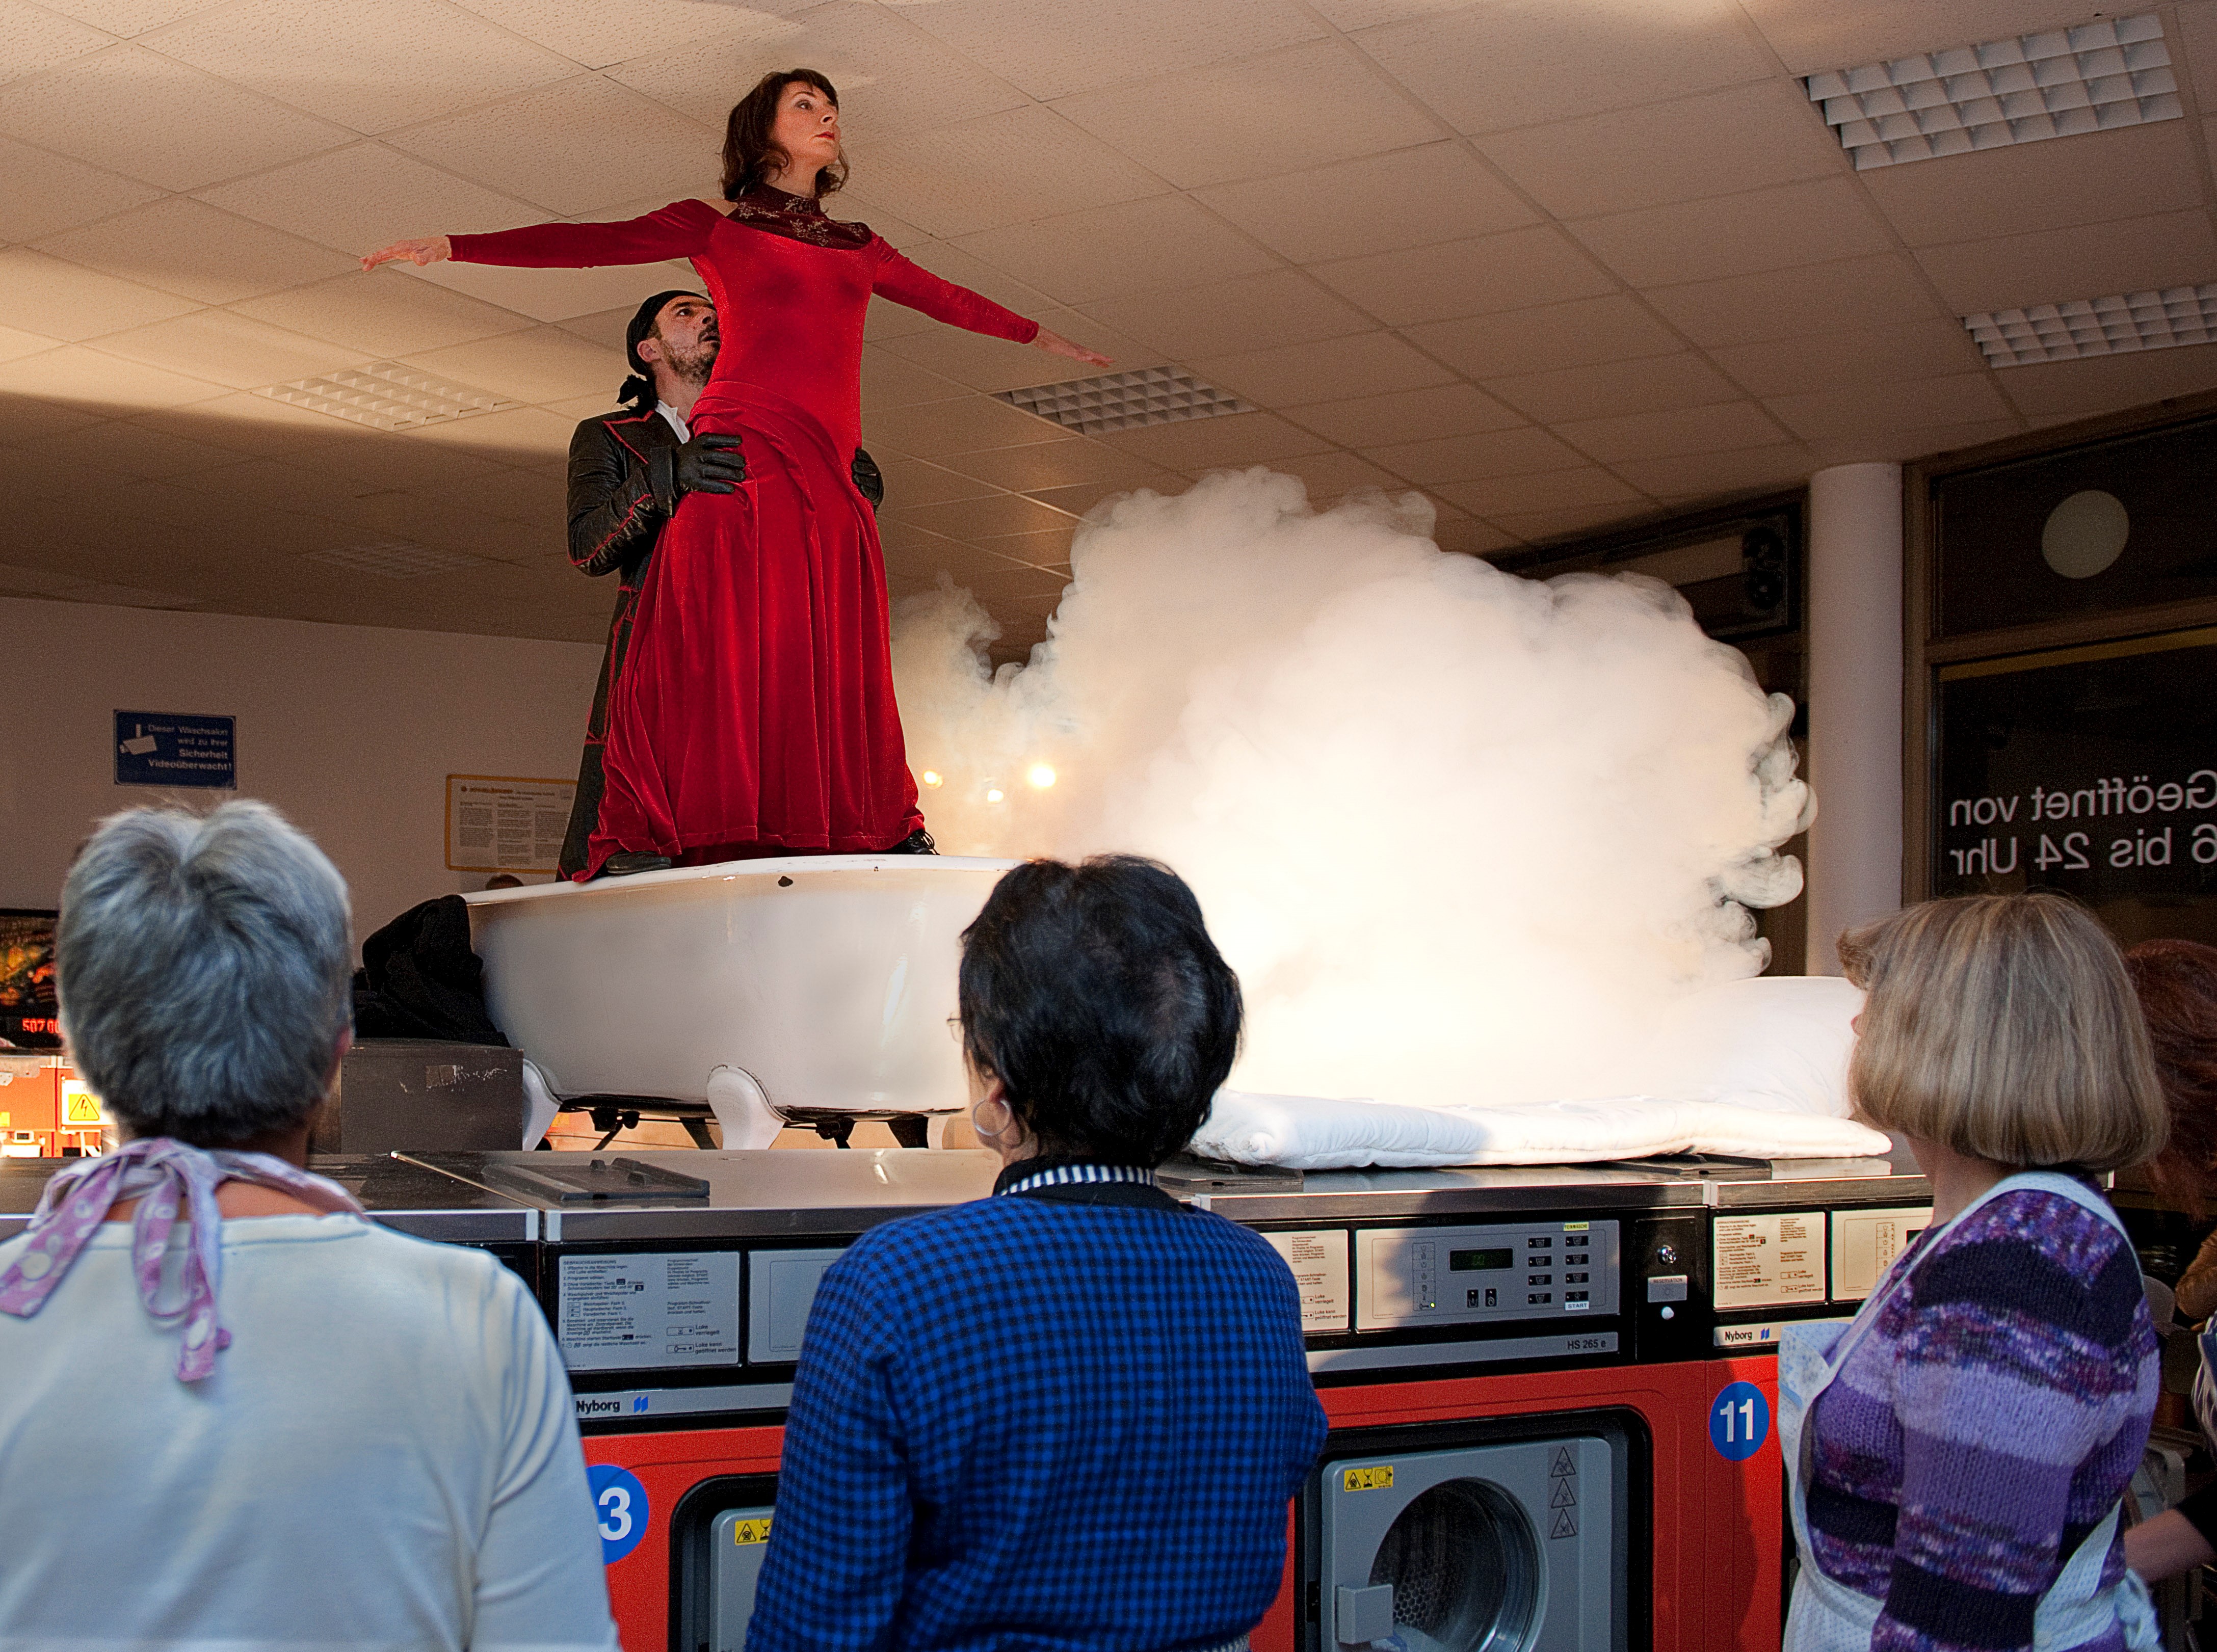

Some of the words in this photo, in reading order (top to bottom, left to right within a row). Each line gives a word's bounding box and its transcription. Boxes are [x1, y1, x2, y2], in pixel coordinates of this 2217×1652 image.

[179, 749, 228, 759] Sicherheit
[1725, 1330, 1752, 1341] Nyborg
[1567, 1340, 1580, 1350] HS
[1583, 1339, 1599, 1349] 265
[576, 1400, 620, 1414] Nyborg
[1720, 1398, 1754, 1443] 11
